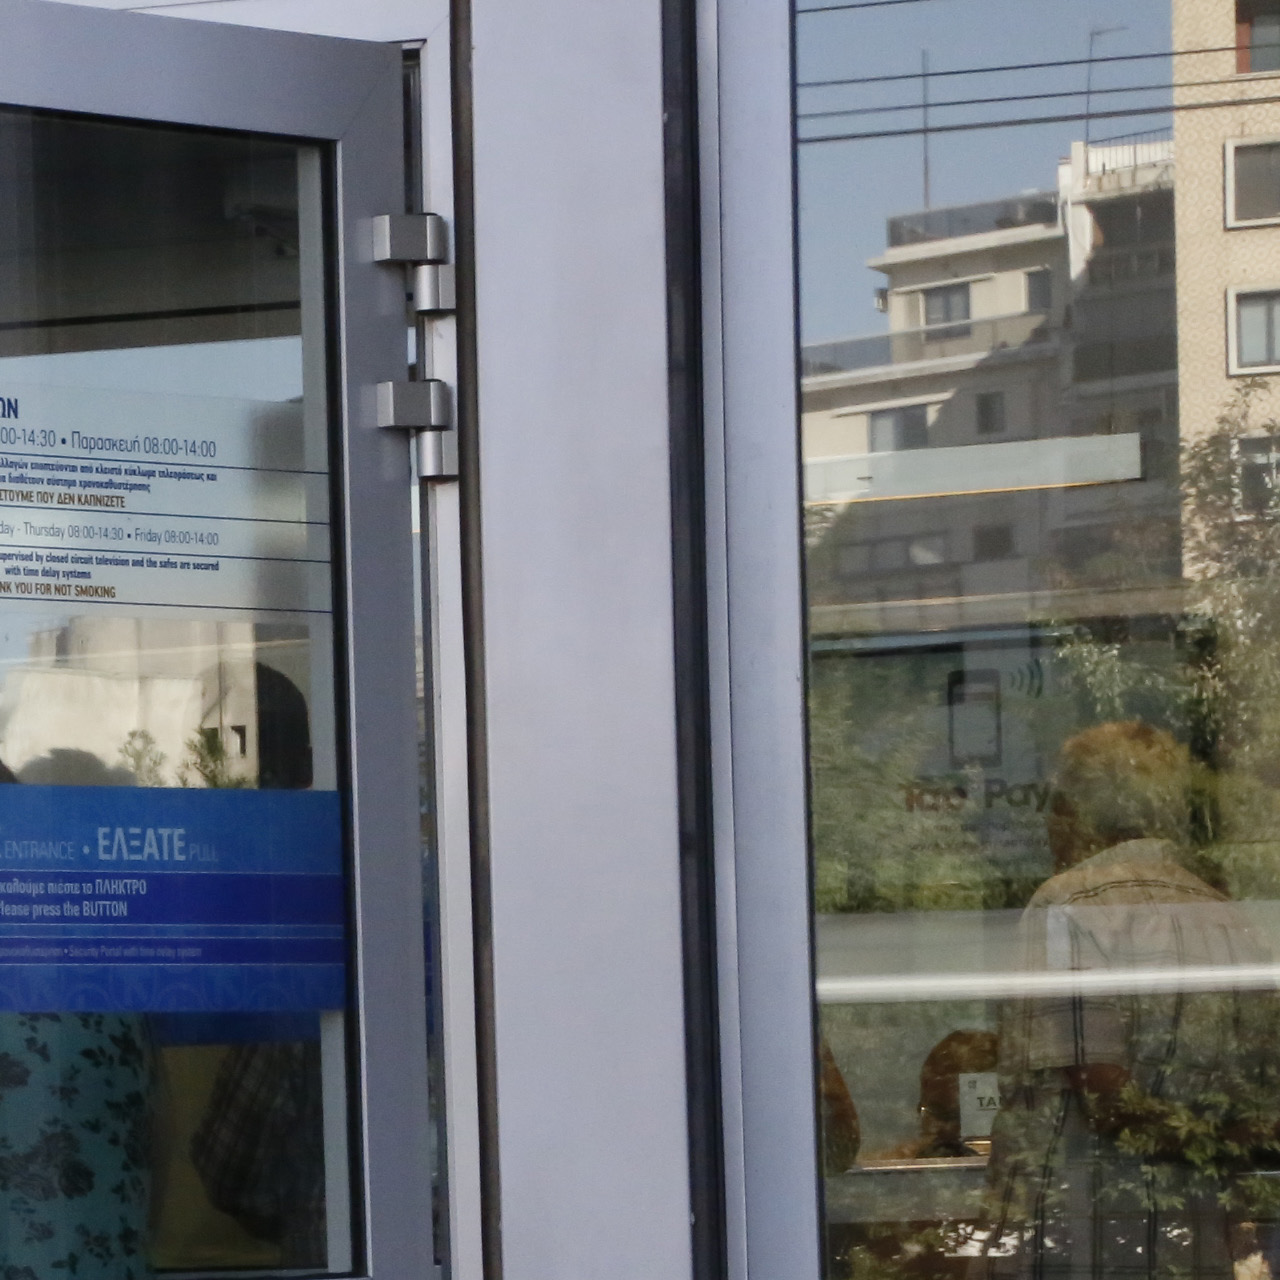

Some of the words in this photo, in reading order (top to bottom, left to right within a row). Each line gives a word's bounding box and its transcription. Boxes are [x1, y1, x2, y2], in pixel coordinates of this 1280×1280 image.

[71, 431, 141, 454] Παρασκευή
[143, 437, 217, 458] 08:00-14:00
[36, 491, 55, 504] ΠΟΥ
[57, 493, 75, 505] ΔΕΝ
[77, 494, 126, 508] ΚΑΠΝΙΖΕΤΕ
[24, 522, 65, 540] Thursday
[134, 528, 163, 545] Friday
[164, 530, 219, 546] 08:00-14:00
[35, 552, 44, 565] by
[46, 553, 69, 564] closed
[71, 554, 93, 565] circuit
[95, 555, 130, 567] television
[132, 557, 144, 567] and
[146, 557, 157, 568] the
[159, 559, 178, 569] safes
[180, 561, 191, 570] are
[192, 560, 219, 571] secured
[5, 565, 21, 576] with
[23, 566, 39, 577] time
[41, 567, 60, 580] delay
[62, 569, 91, 581] systems
[15, 581, 33, 595] YOU
[35, 583, 52, 595] FOR
[54, 584, 72, 596] NOT
[75, 585, 116, 598] SMOKING
[4, 840, 75, 861] ENTRANCE
[97, 826, 187, 862] ΕΛΞΑΤΕ
[48, 879, 80, 895] πιέστε
[83, 883, 93, 895] το
[95, 879, 147, 895] ΠΛΗΚΤΡΟ
[32, 904, 61, 920] press
[63, 901, 80, 916] the
[83, 901, 128, 917] BUTTON
